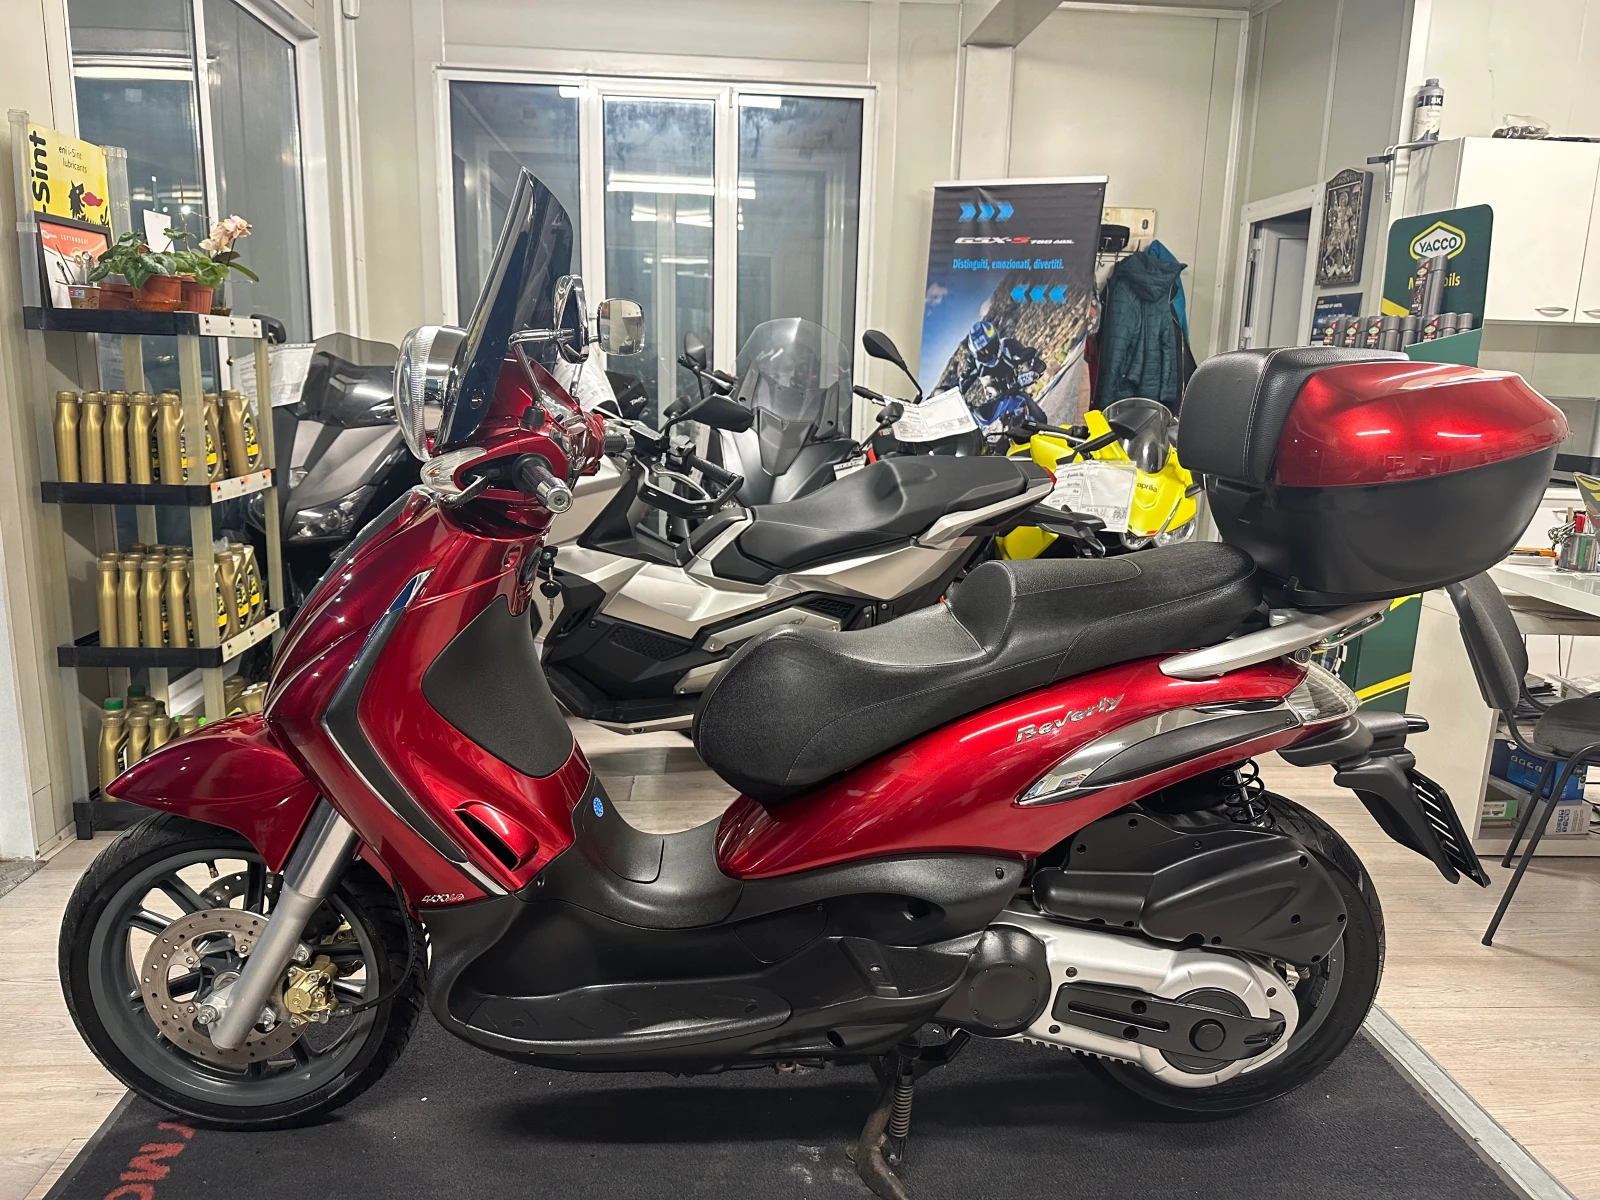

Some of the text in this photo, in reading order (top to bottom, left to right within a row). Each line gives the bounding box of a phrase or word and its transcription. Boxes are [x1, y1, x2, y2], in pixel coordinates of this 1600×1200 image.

[62, 157, 88, 174] lubricants
[1419, 236, 1457, 253] YACCO
[952, 258, 1064, 271] Distinguiti, emozionati, divertiti.
[1136, 482, 1158, 493] aprilia
[1015, 693, 1125, 742] Beverly
